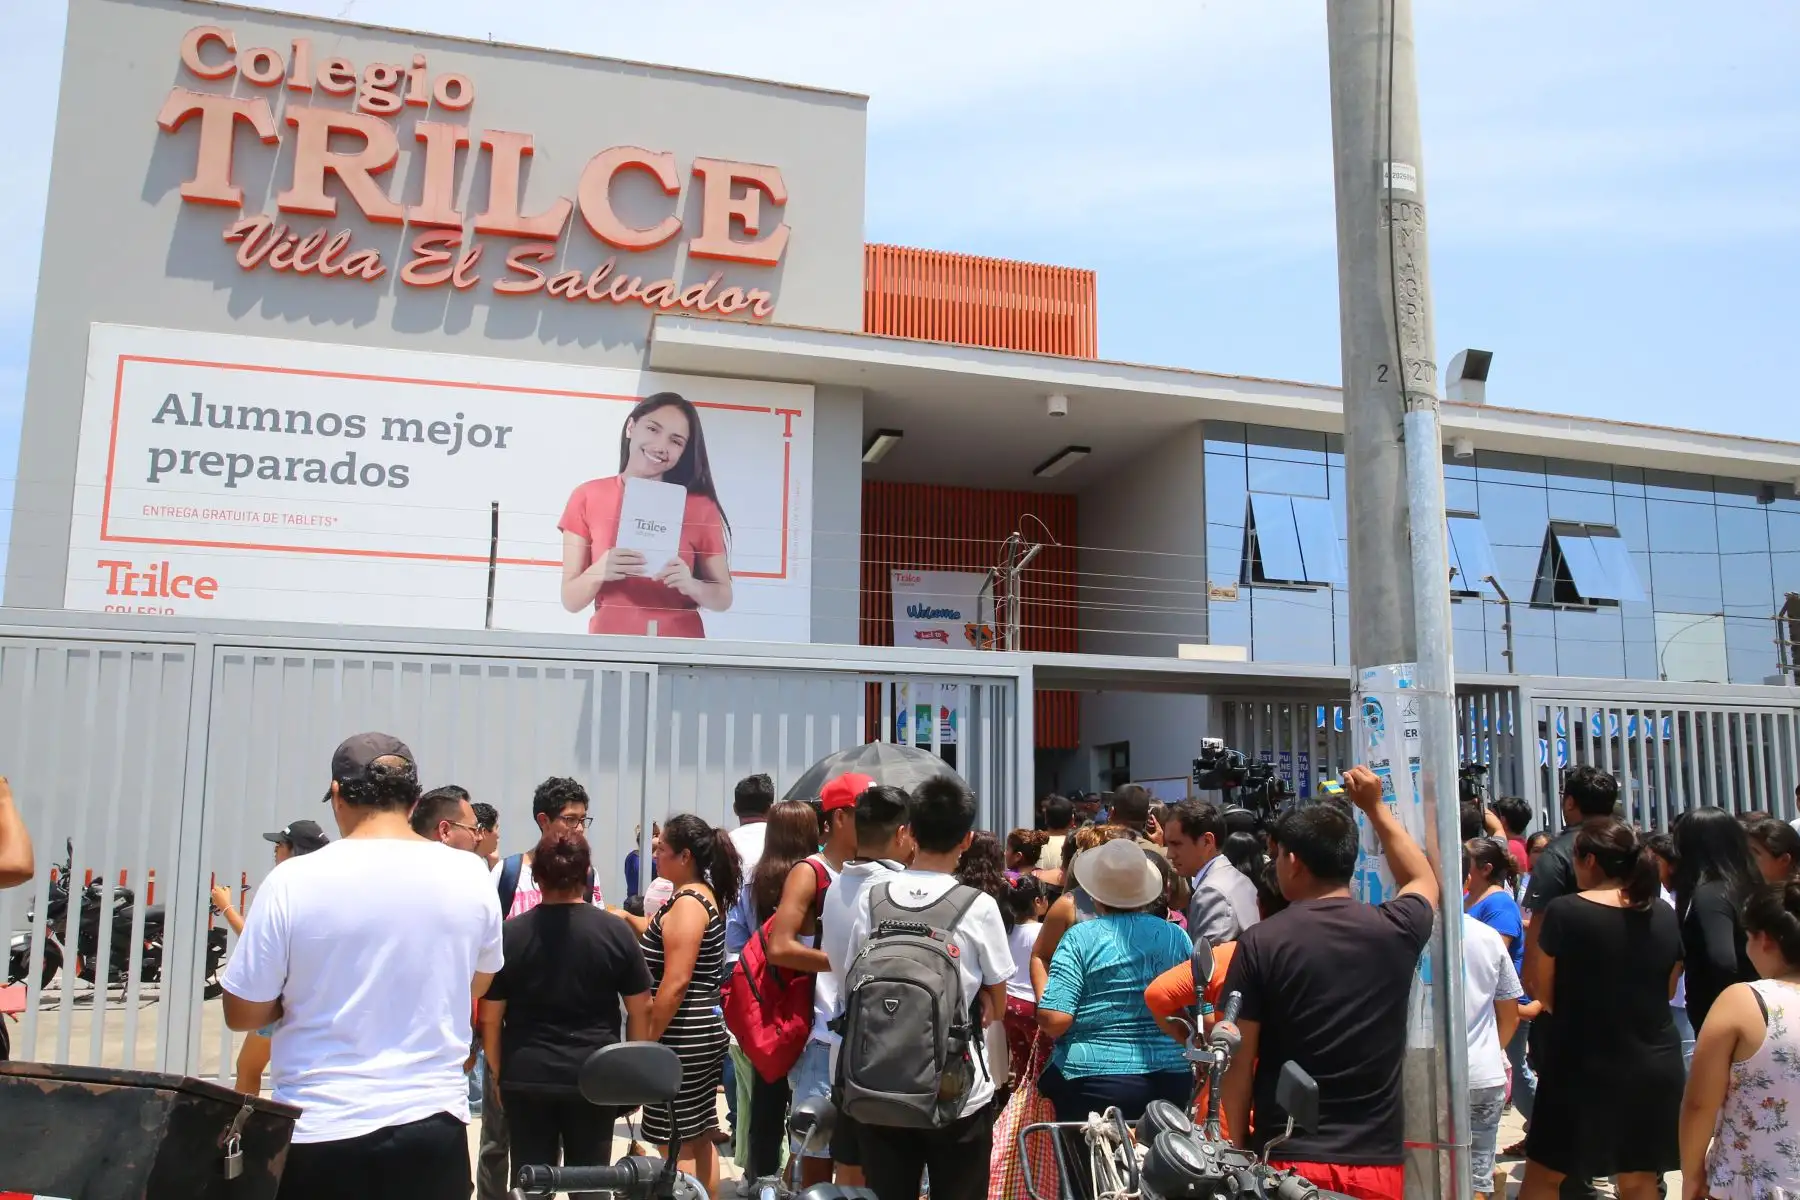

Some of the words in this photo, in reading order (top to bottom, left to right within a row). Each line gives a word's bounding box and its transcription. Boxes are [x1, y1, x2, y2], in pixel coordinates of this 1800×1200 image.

[180, 25, 475, 116] Colegio
[157, 86, 791, 266] TRILCE
[223, 213, 388, 281] Villa
[400, 228, 480, 291] El
[493, 243, 775, 318] Salvador
[1377, 364, 1389, 383] 2
[152, 392, 367, 439] Alumnos
[381, 412, 513, 455] mejor
[775, 408, 801, 437] T
[146, 445, 411, 489] preparados
[142, 505, 199, 519] ENTREGA
[202, 509, 260, 522] GRATUITA
[263, 512, 279, 523] DE
[635, 518, 667, 533] Trilce
[97, 559, 219, 600] Trilce
[894, 572, 921, 584] Trilce
[906, 602, 961, 620] Welcome
